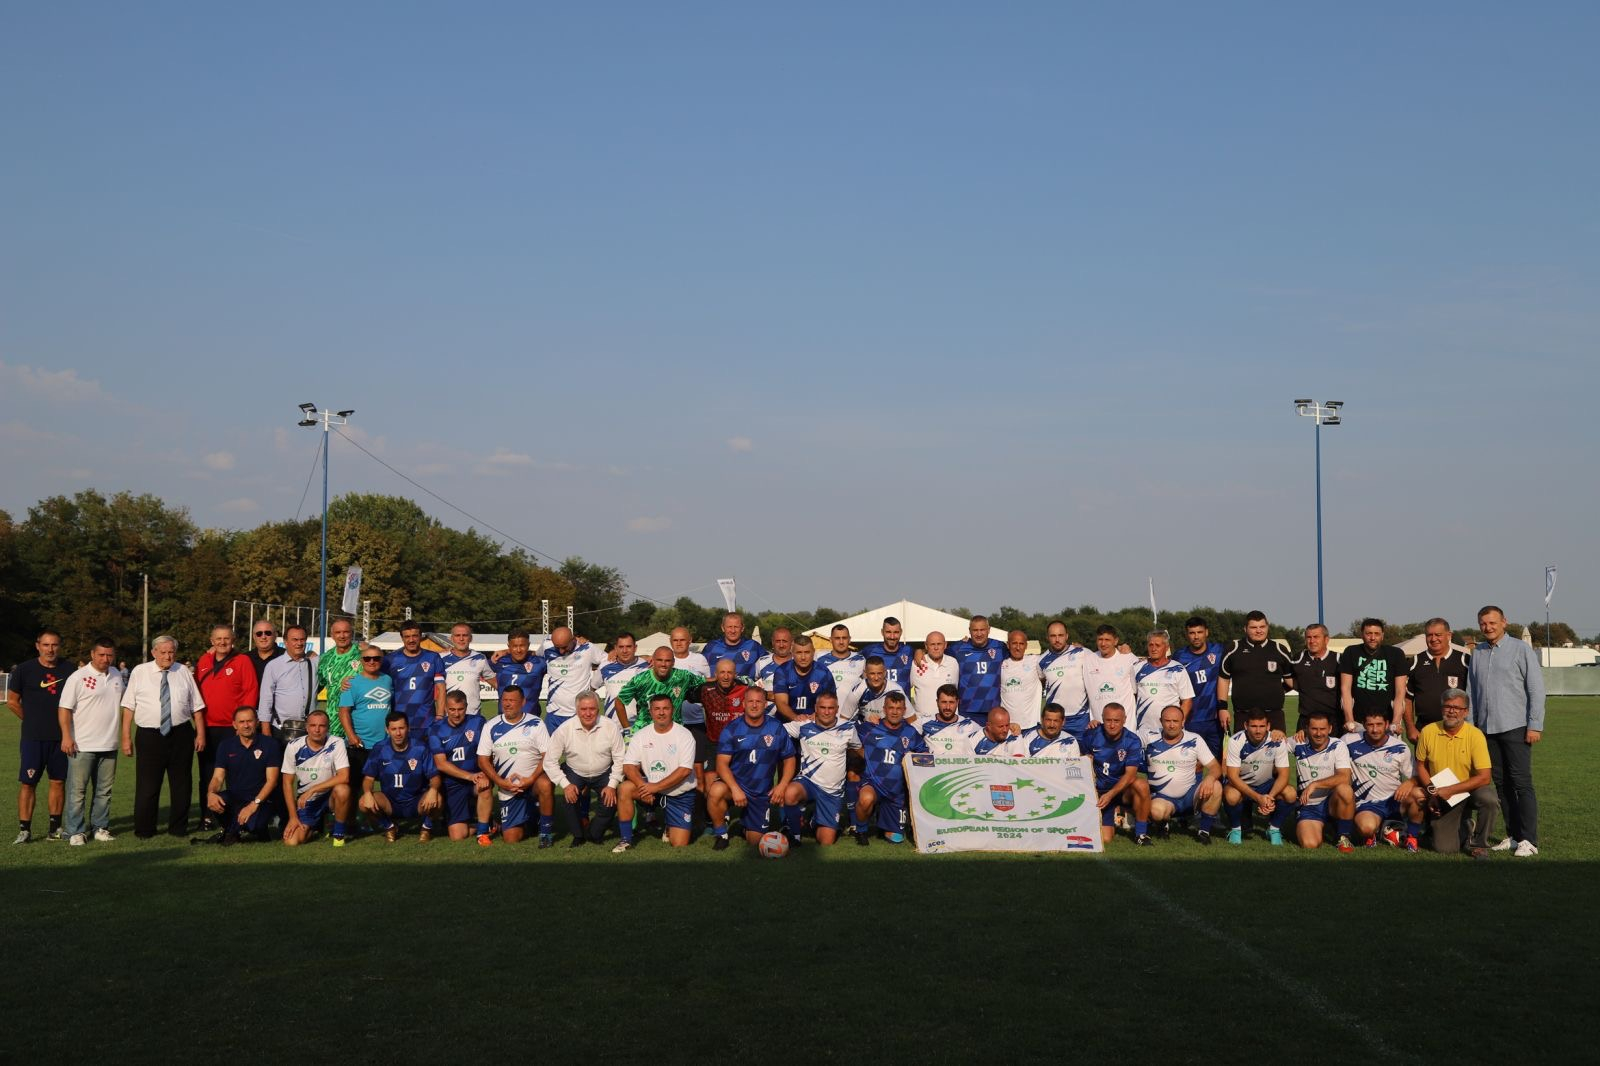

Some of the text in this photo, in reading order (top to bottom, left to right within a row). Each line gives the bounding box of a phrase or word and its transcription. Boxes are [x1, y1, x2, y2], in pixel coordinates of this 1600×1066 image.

[976, 661, 987, 674] 19
[511, 673, 519, 685] 2
[886, 669, 898, 681] 13
[1195, 669, 1207, 684] 18
[409, 676, 417, 690] 6
[367, 703, 391, 711] umbr
[796, 696, 807, 710] 10
[452, 747, 466, 761] 20
[749, 749, 757, 764] 4
[883, 749, 896, 764] 16
[1021, 757, 1061, 765] COUNTY
[1102, 762, 1111, 776] 8
[394, 774, 404, 788] 11
[898, 809, 907, 823] 16
[936, 826, 990, 835] EUROPEAN
[1046, 827, 1078, 835] SPORT
[927, 840, 945, 848] aces
